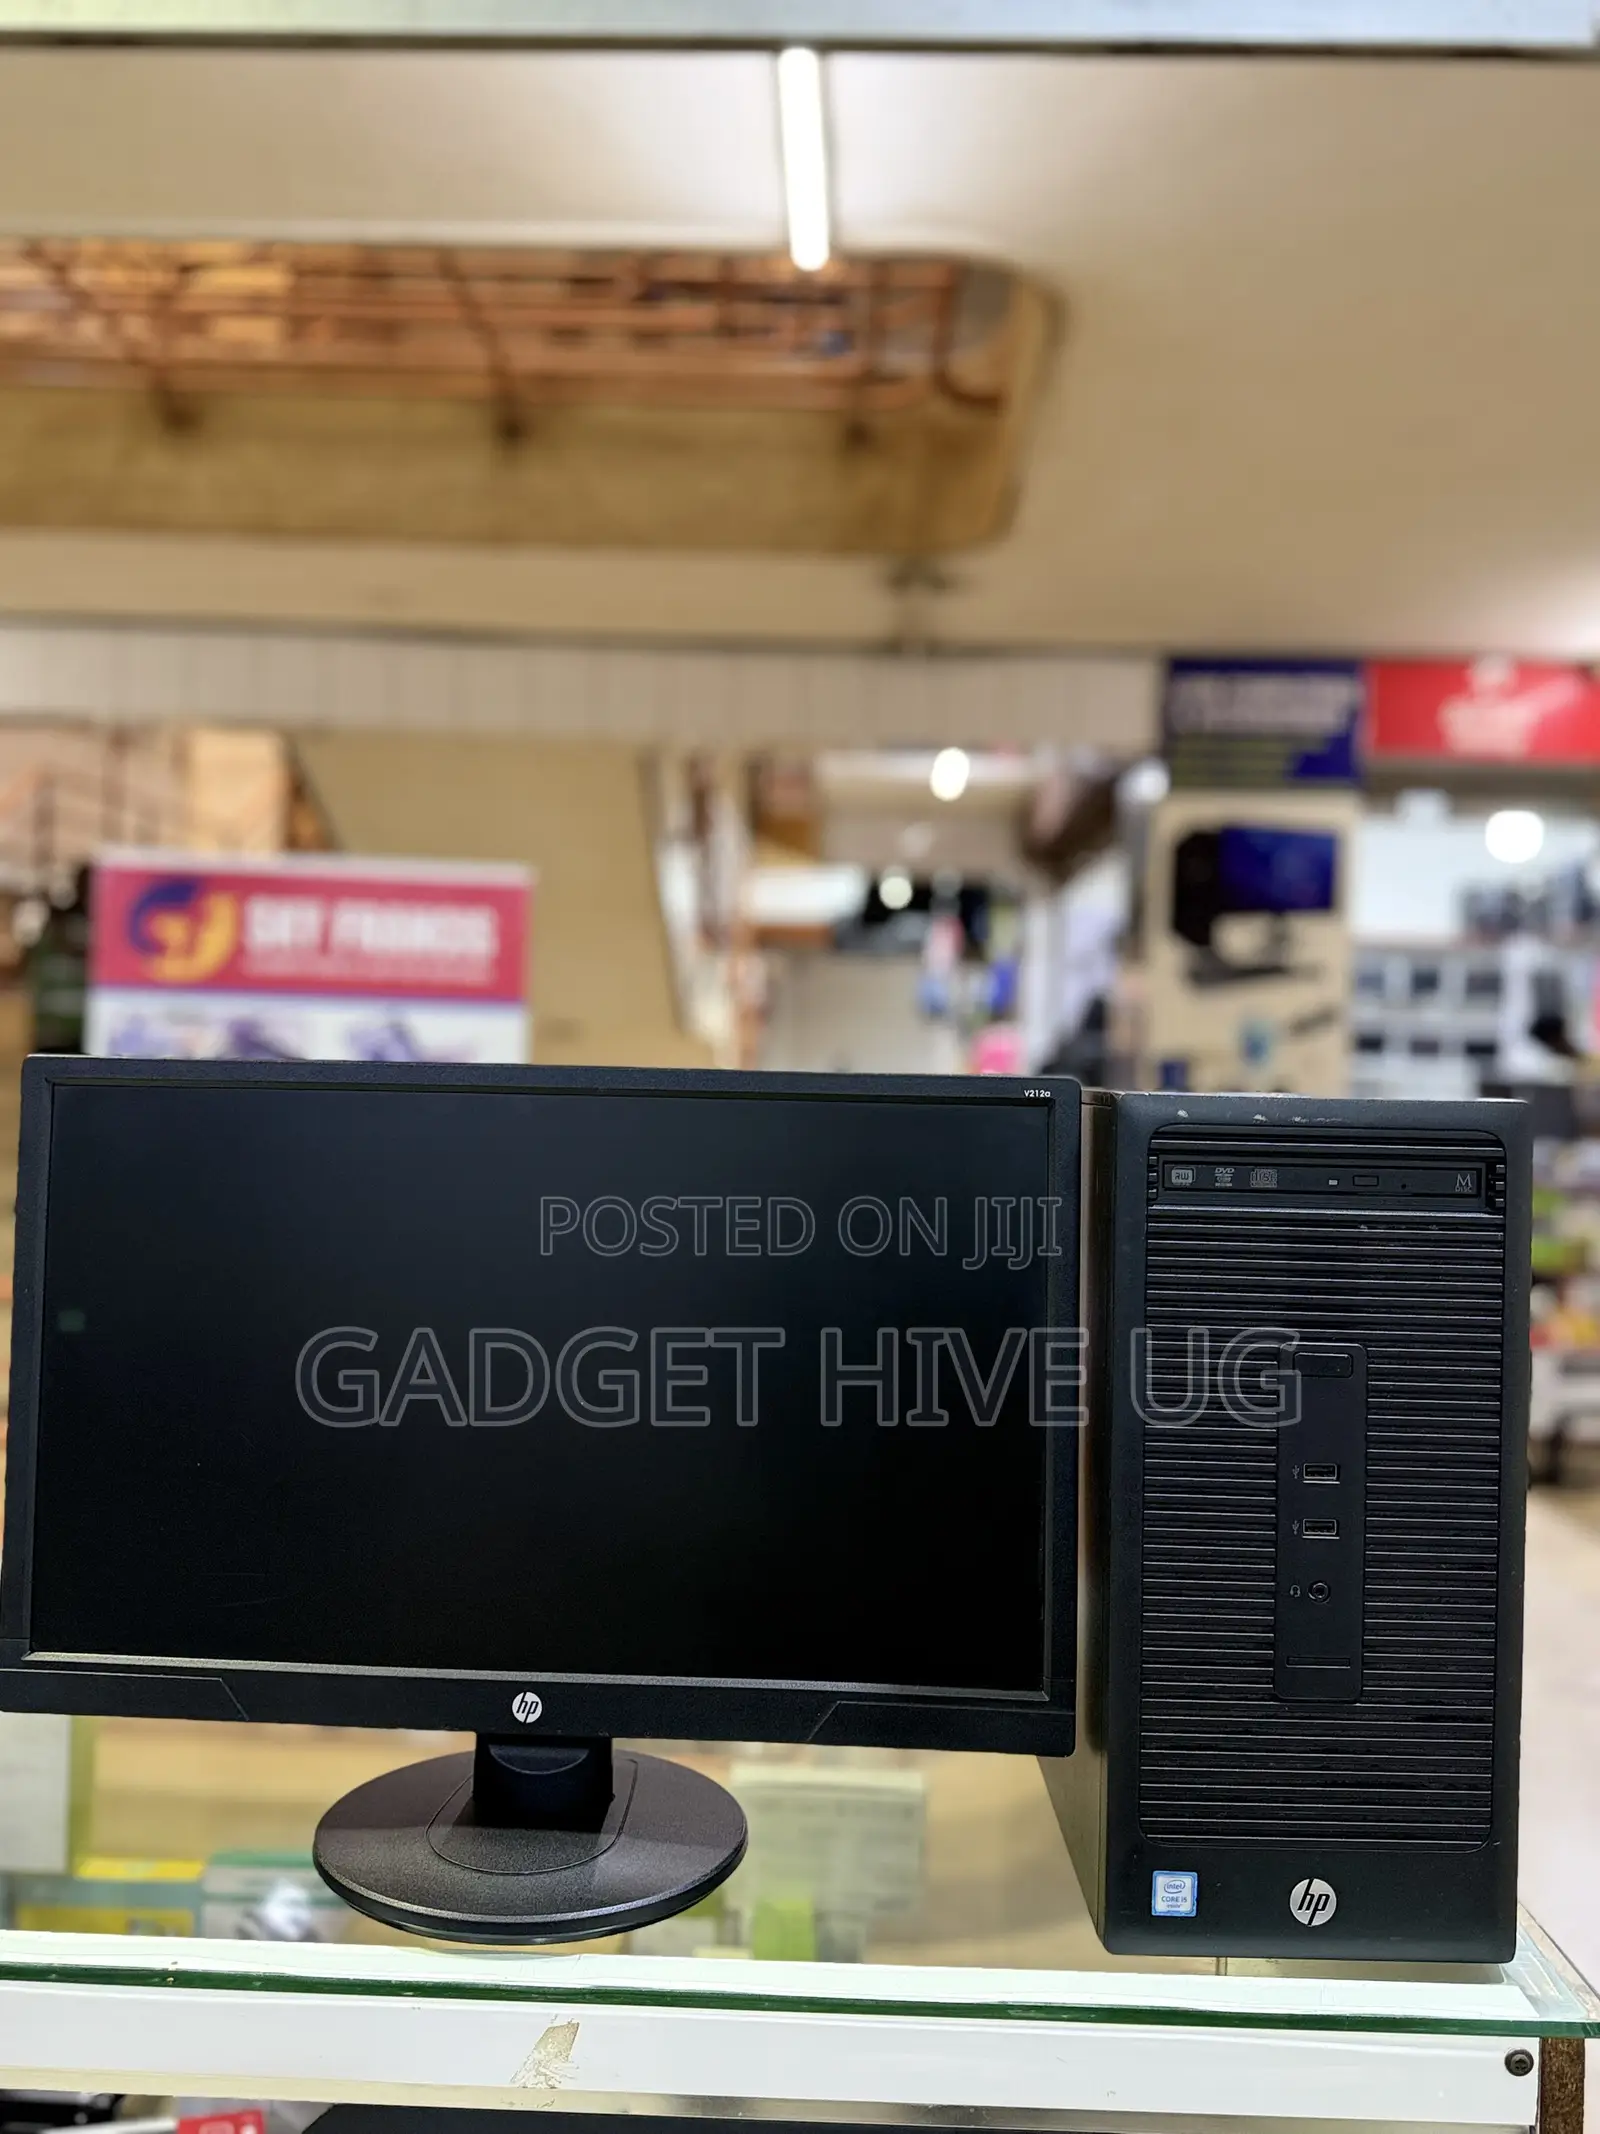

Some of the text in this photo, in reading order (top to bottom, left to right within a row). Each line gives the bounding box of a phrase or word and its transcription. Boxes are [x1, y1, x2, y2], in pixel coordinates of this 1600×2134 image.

[1023, 1089, 1051, 1098] V212a
[512, 1691, 542, 1723] hp
[1161, 1895, 1180, 1903] CORE
[1290, 1878, 1337, 1926] hp
